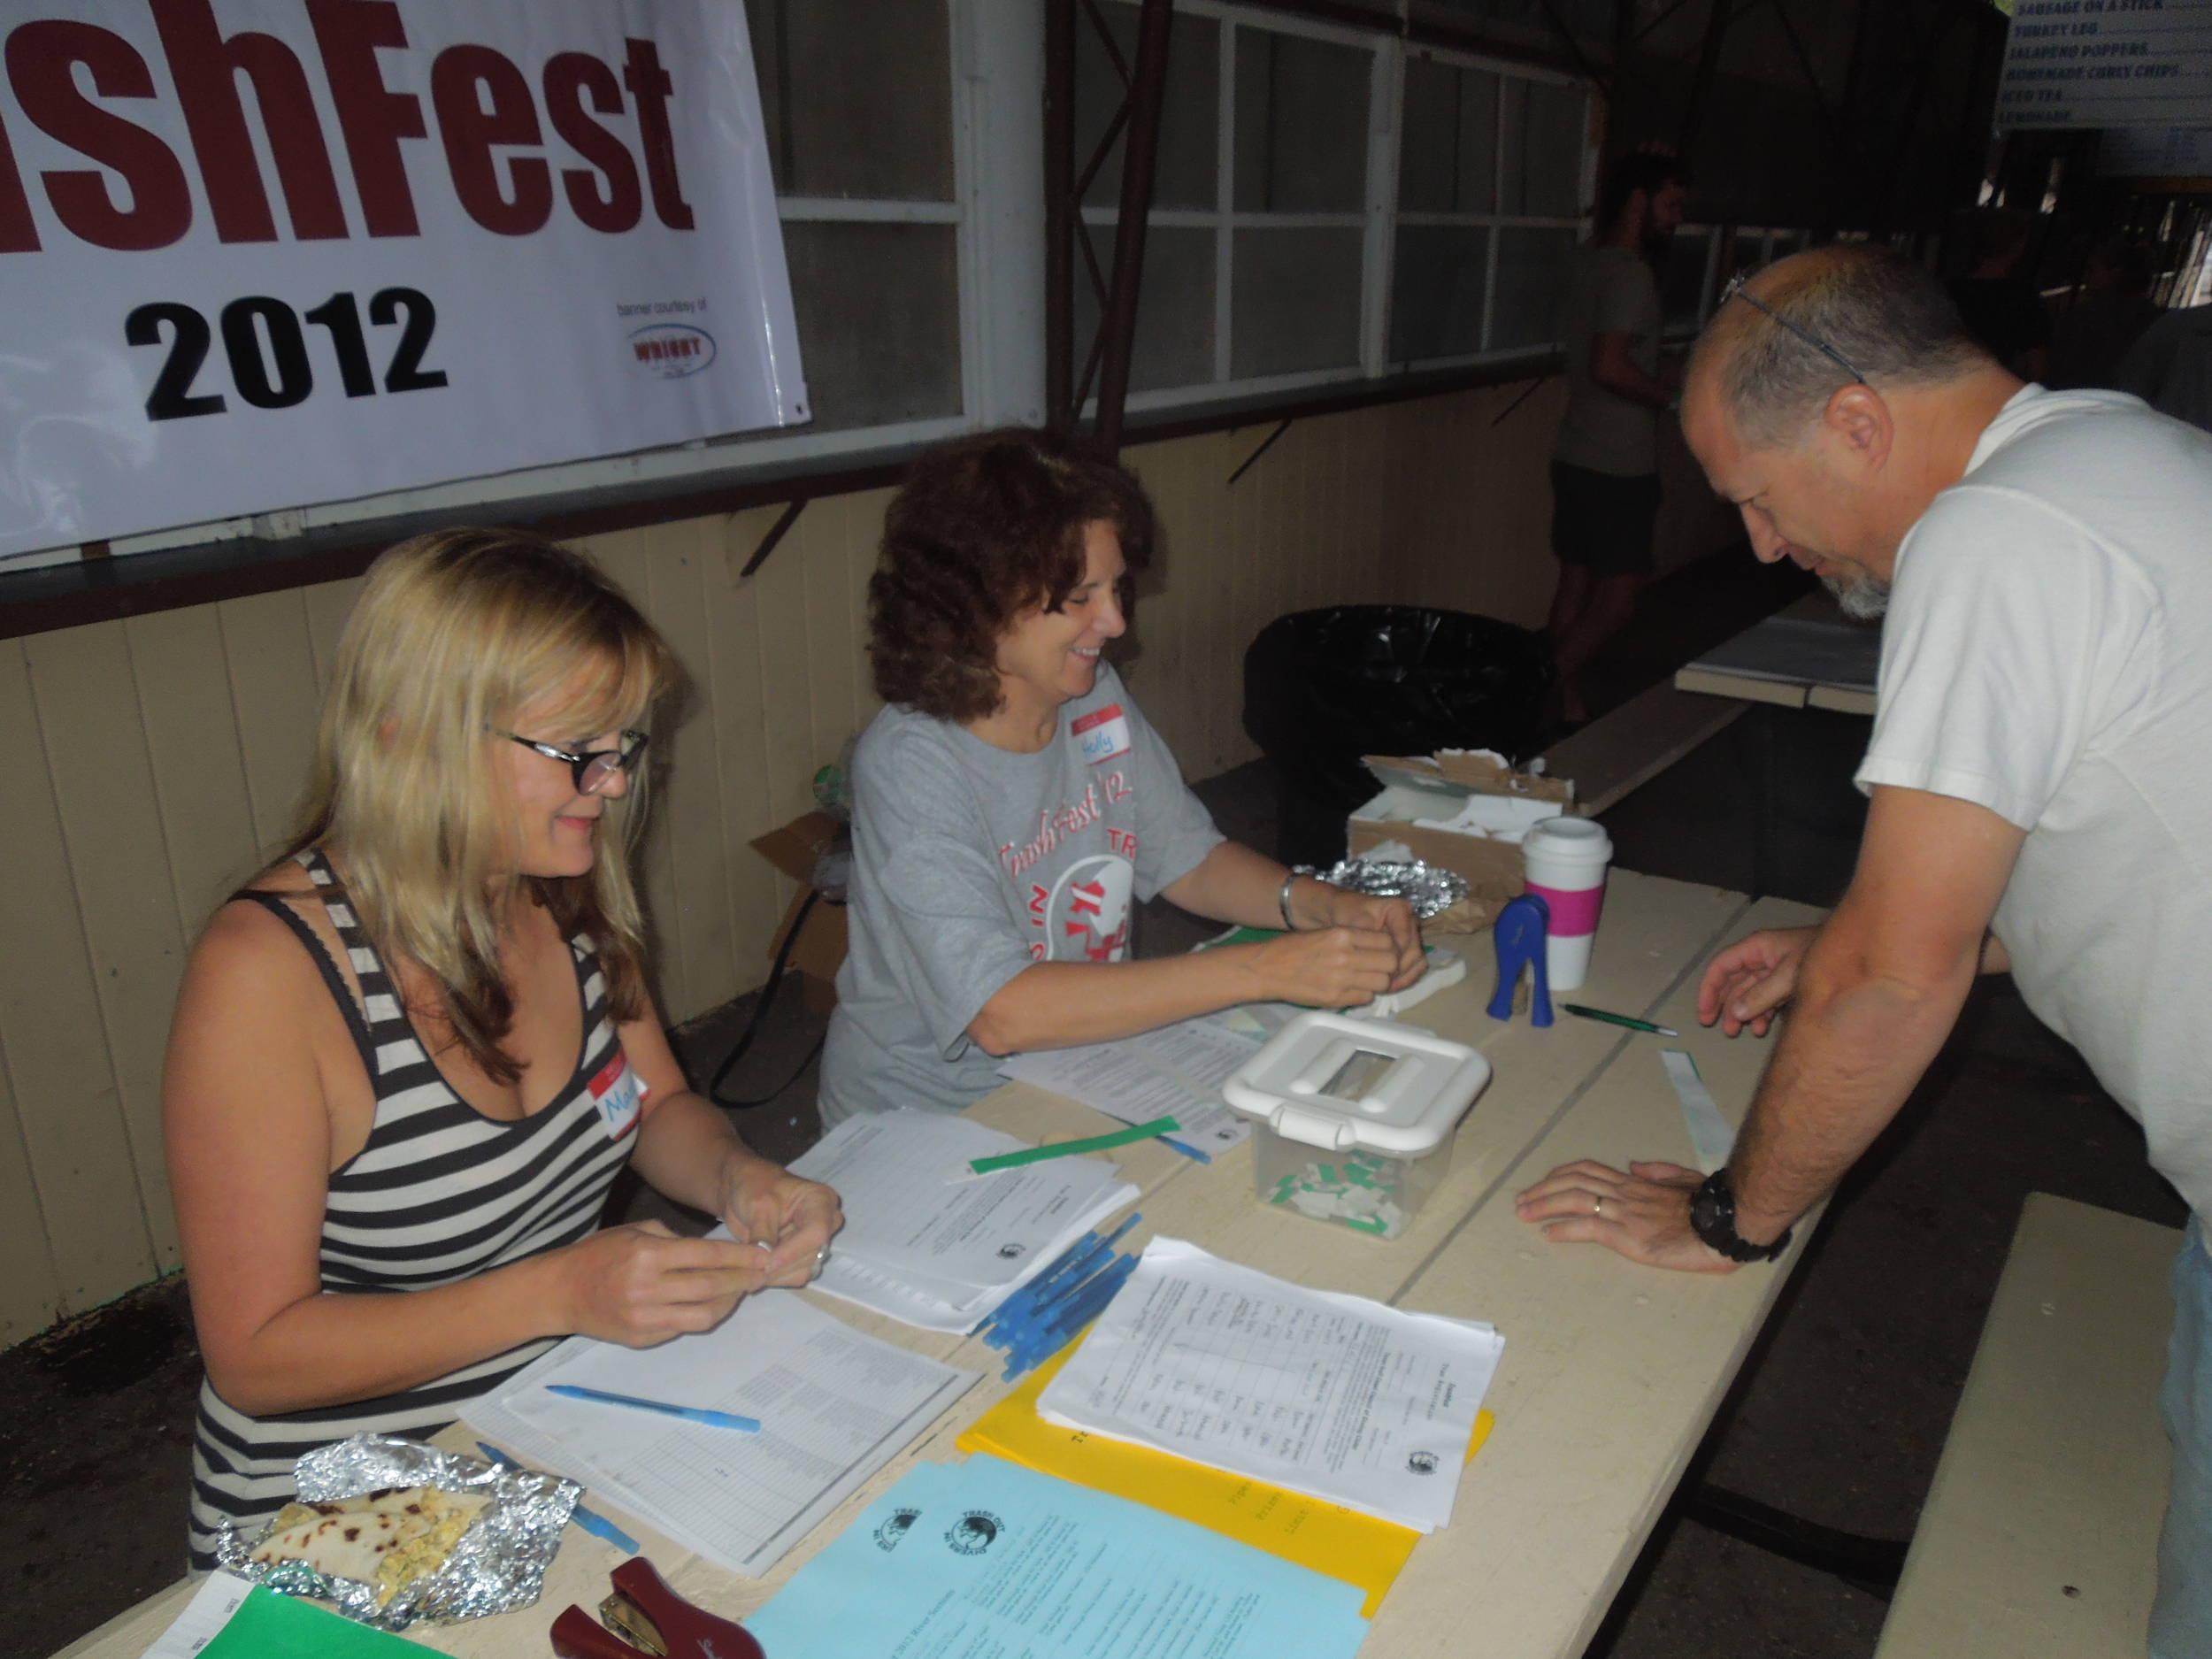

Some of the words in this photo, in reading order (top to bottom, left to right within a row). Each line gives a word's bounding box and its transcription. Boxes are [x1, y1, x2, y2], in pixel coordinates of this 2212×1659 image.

[616, 301, 652, 317] banner
[654, 298, 695, 314] courtesy
[697, 296, 708, 311] of
[125, 286, 449, 422] 2012
[963, 1509, 994, 1518] TRASH
[992, 1517, 1006, 1533] OUT
[943, 1532, 952, 1542] IN
[949, 1543, 987, 1556] DIVERS
